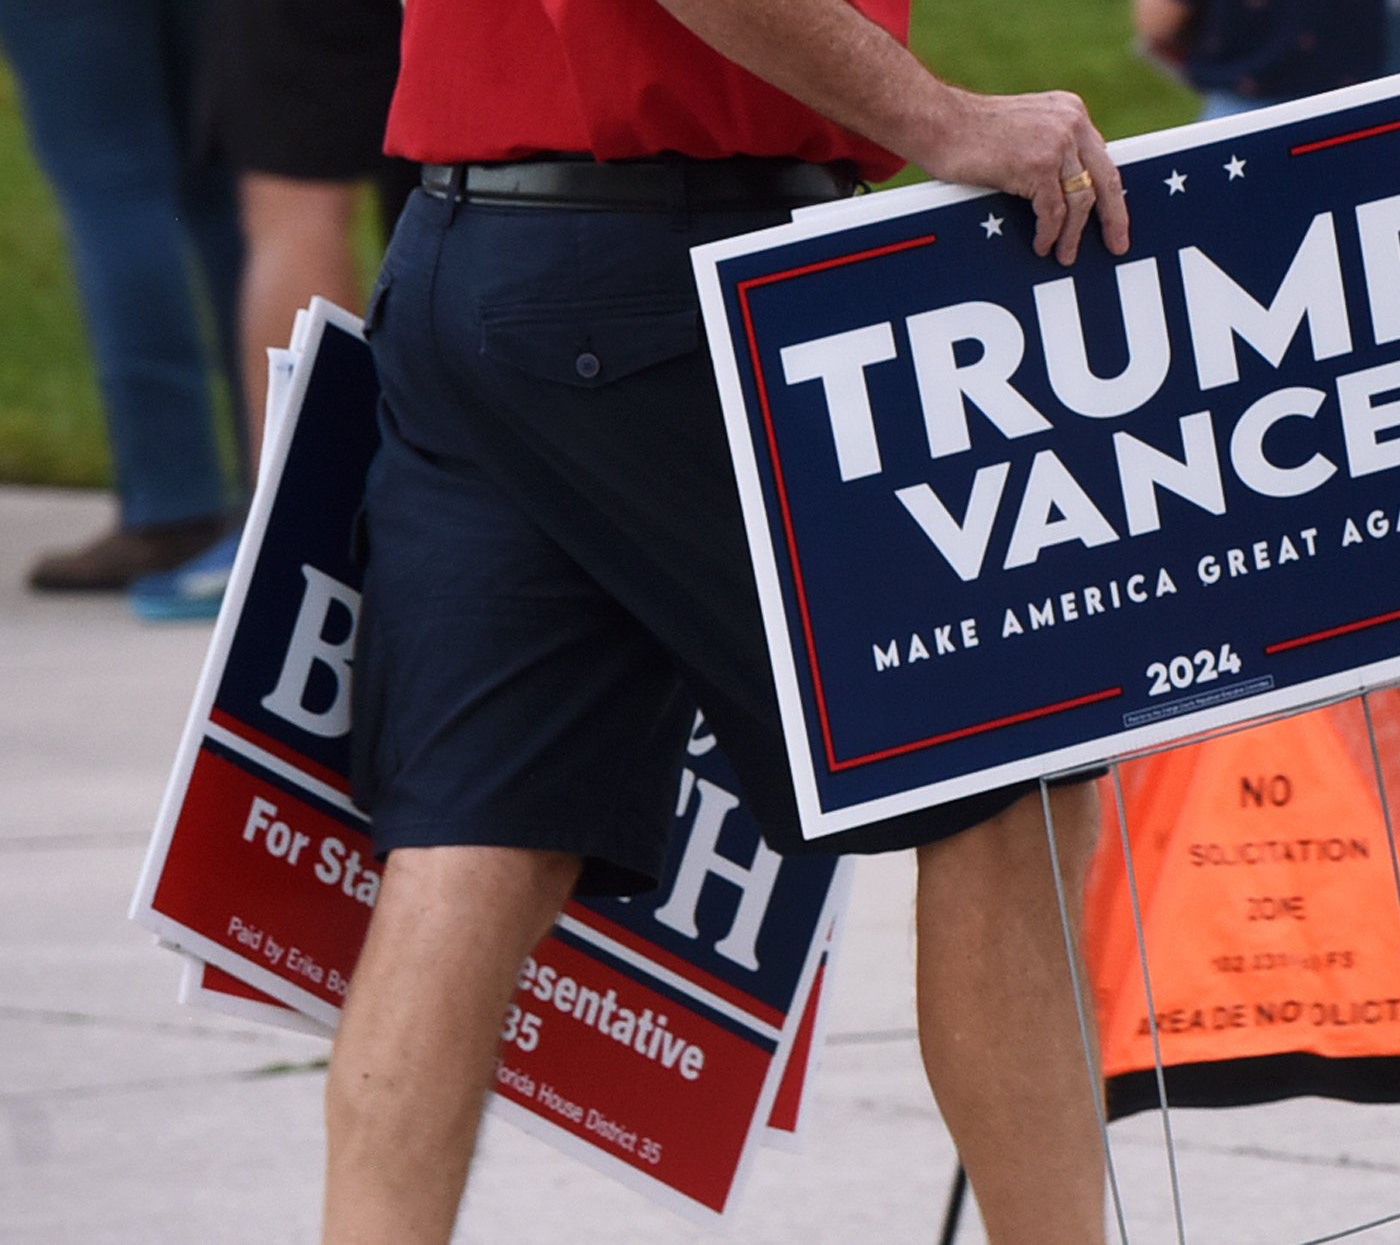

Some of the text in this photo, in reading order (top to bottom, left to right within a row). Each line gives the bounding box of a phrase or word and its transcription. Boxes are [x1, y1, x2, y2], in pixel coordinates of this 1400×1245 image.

[872, 619, 979, 672] MAKE
[1001, 568, 1177, 640] AMERICA
[1198, 528, 1317, 585] GREAT
[1146, 643, 1242, 697] 2024
[1240, 774, 1292, 808] NO
[227, 915, 263, 950] Paid
[264, 935, 284, 965] by
[286, 948, 324, 984] Erika
[242, 795, 705, 1081] For Sta esentative
[1254, 1000, 1301, 1028] NO
[537, 1081, 584, 1123] House
[584, 1108, 638, 1152] District
[637, 1136, 663, 1165] 35
